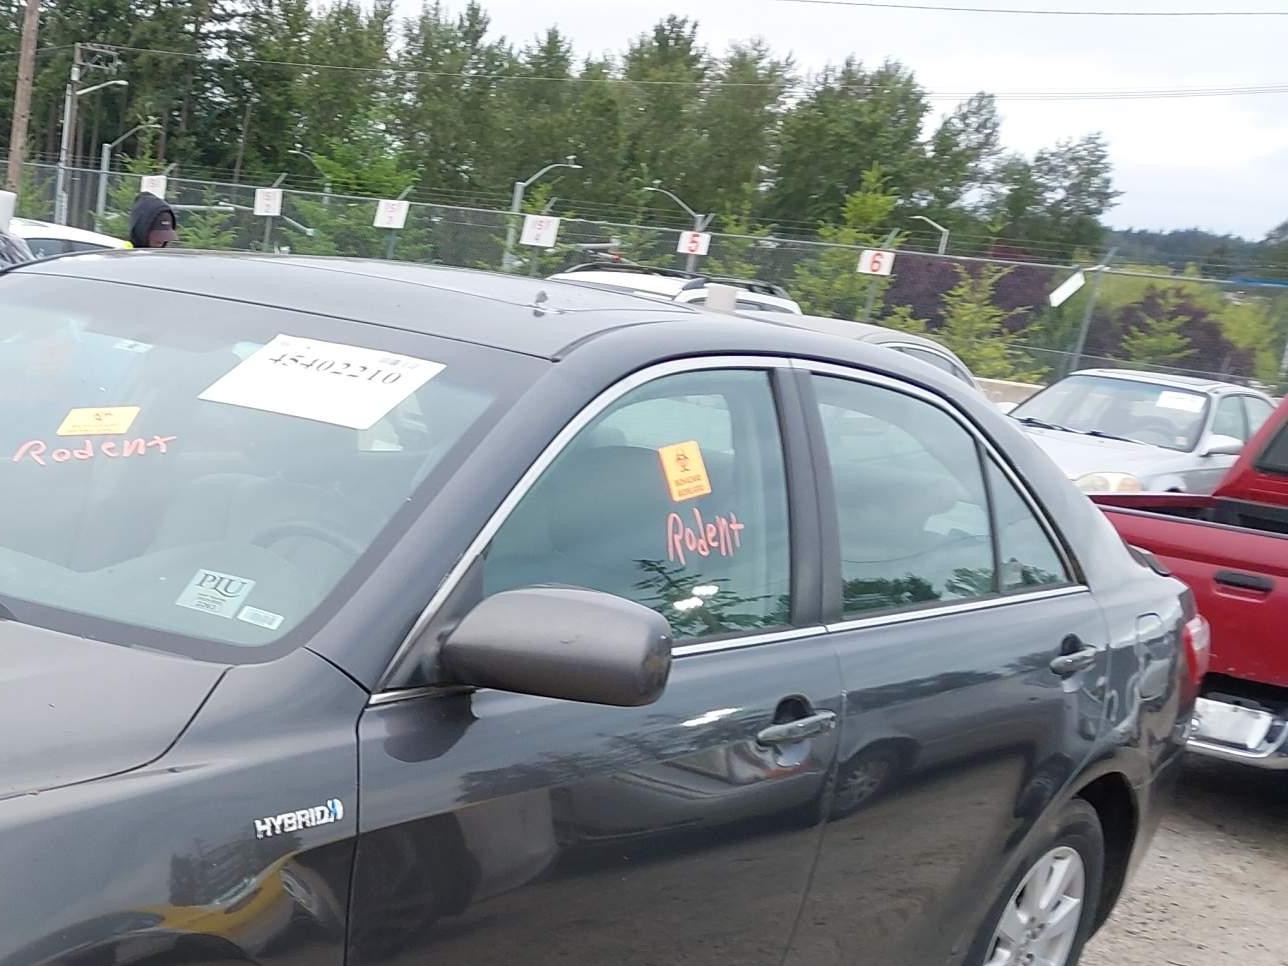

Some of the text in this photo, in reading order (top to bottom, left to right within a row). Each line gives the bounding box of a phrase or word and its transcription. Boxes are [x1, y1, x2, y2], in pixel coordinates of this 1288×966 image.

[688, 234, 701, 253] 5
[870, 252, 883, 273] 6
[269, 353, 402, 384] 45402210
[12, 435, 177, 466] Rodent
[667, 507, 744, 566] Rodent
[195, 573, 248, 598] PLU
[254, 805, 332, 839] HYBRID
